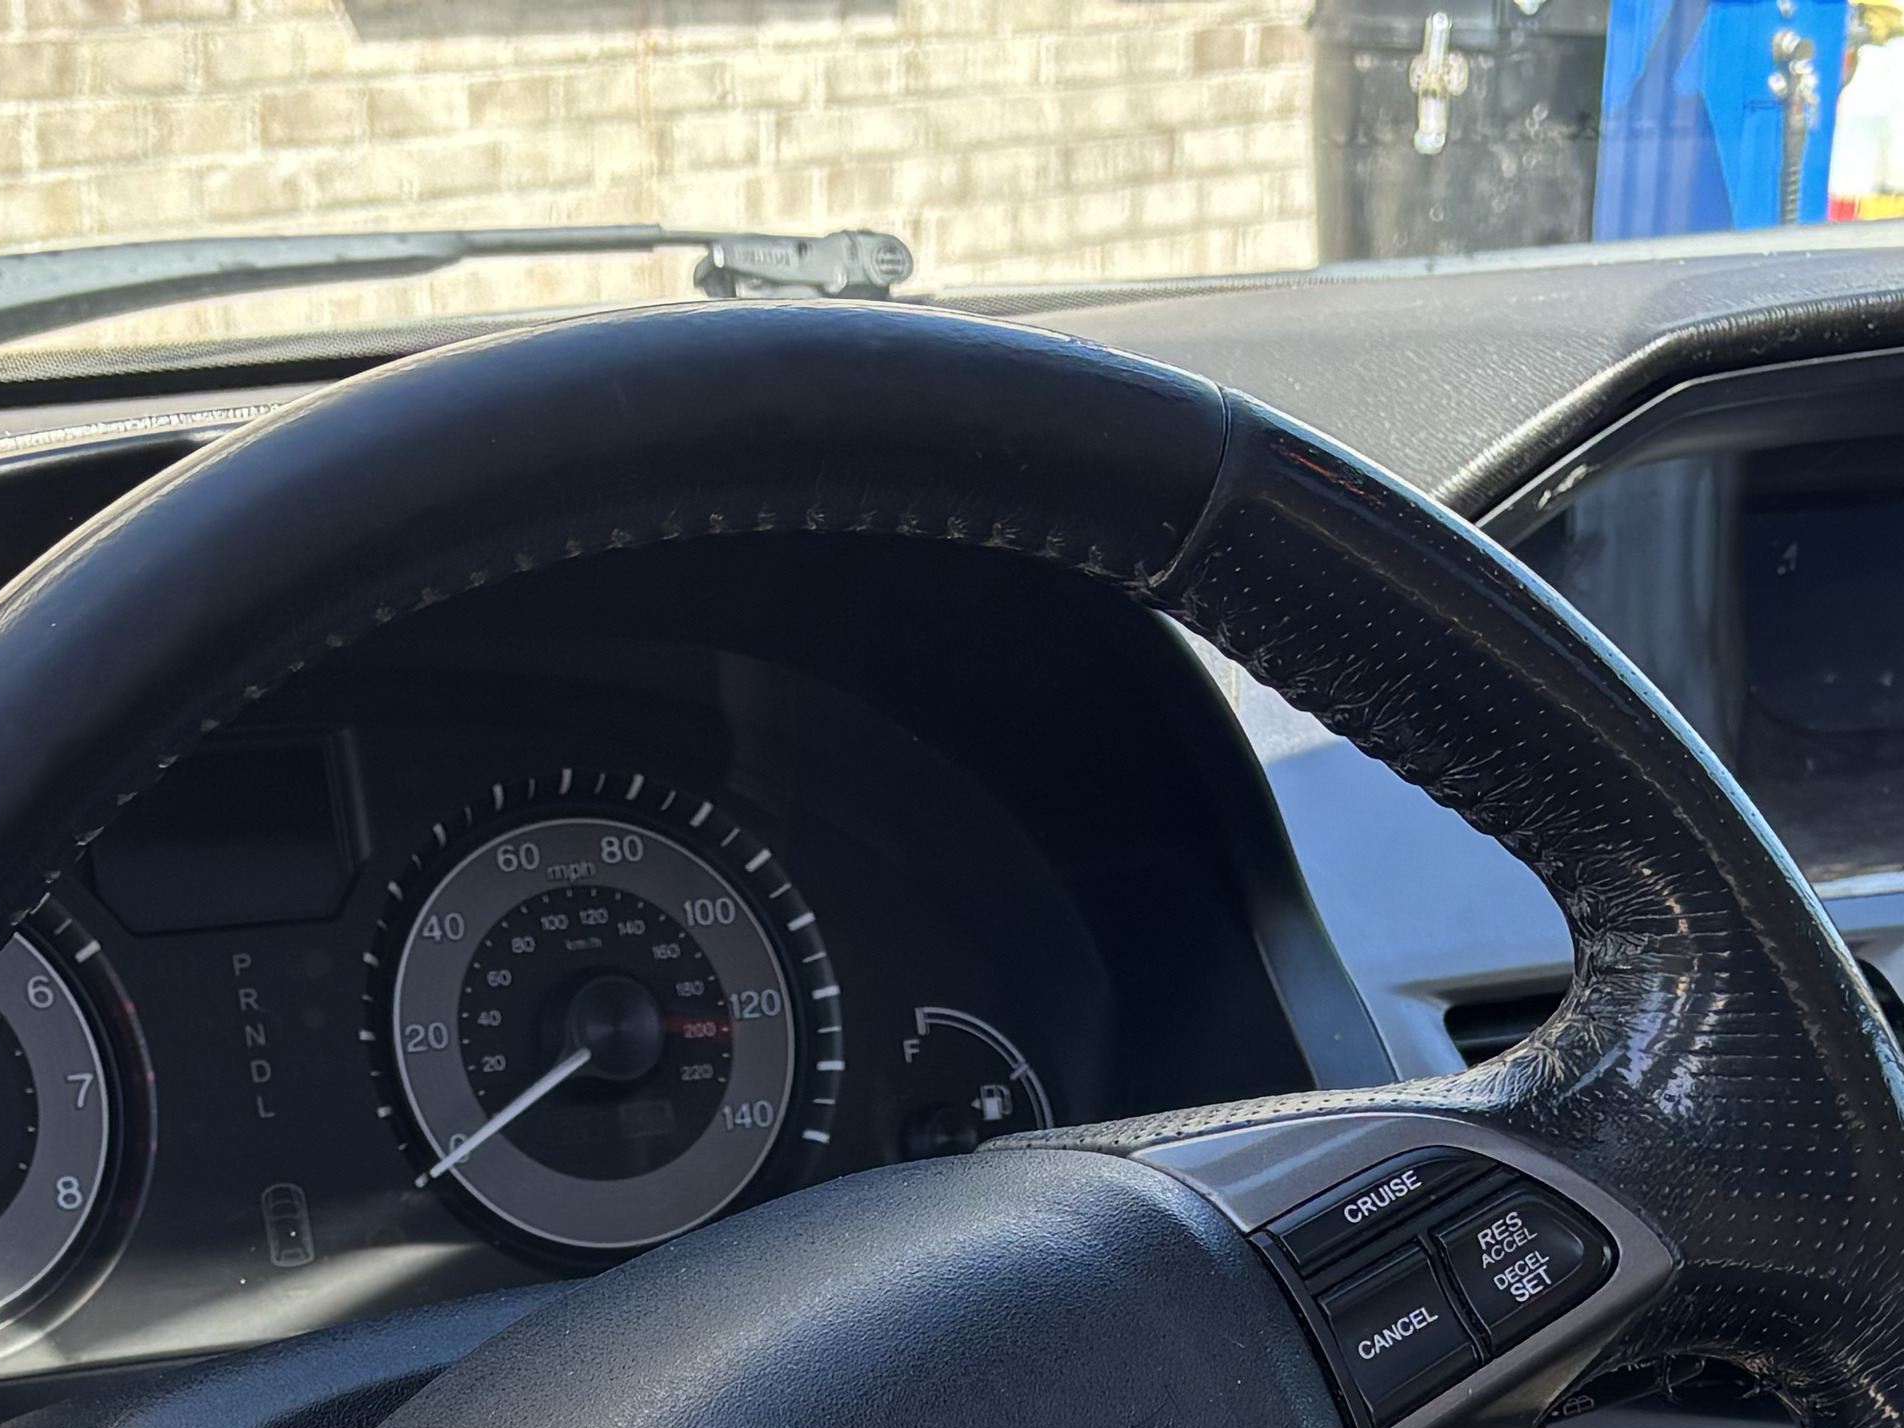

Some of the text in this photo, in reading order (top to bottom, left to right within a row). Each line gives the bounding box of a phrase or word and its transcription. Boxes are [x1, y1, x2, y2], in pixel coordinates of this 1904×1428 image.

[496, 842, 540, 871] 60
[601, 835, 644, 863] 80
[547, 859, 596, 880] mph
[540, 914, 568, 931] 100
[580, 909, 608, 925] 120
[683, 898, 736, 926] 100
[422, 913, 465, 941] 40
[618, 919, 645, 936] 140
[512, 937, 535, 953] 80
[652, 943, 680, 960] 160
[234, 953, 250, 976] P
[487, 970, 511, 986] 60
[676, 981, 704, 996] 180
[27, 975, 53, 1008] 6
[239, 989, 257, 1010] R
[728, 990, 781, 1019] 120
[478, 1010, 501, 1026] 40
[246, 1025, 266, 1047] N
[404, 1023, 449, 1052] 20
[684, 1022, 715, 1038] 200
[903, 1039, 920, 1063] F
[251, 1061, 269, 1082] D
[483, 1056, 505, 1071] 20
[682, 1064, 713, 1080] 220
[66, 1073, 93, 1109] 7
[257, 1096, 276, 1118] L
[721, 1101, 774, 1130] 140
[56, 1176, 82, 1209] 8
[1344, 1170, 1422, 1224] CRUISE
[1477, 1211, 1523, 1250] RES
[1481, 1227, 1537, 1269] ACCEL
[1494, 1250, 1549, 1291] DECEL
[1511, 1266, 1554, 1303] SET
[1357, 1306, 1438, 1360] CANCEL
